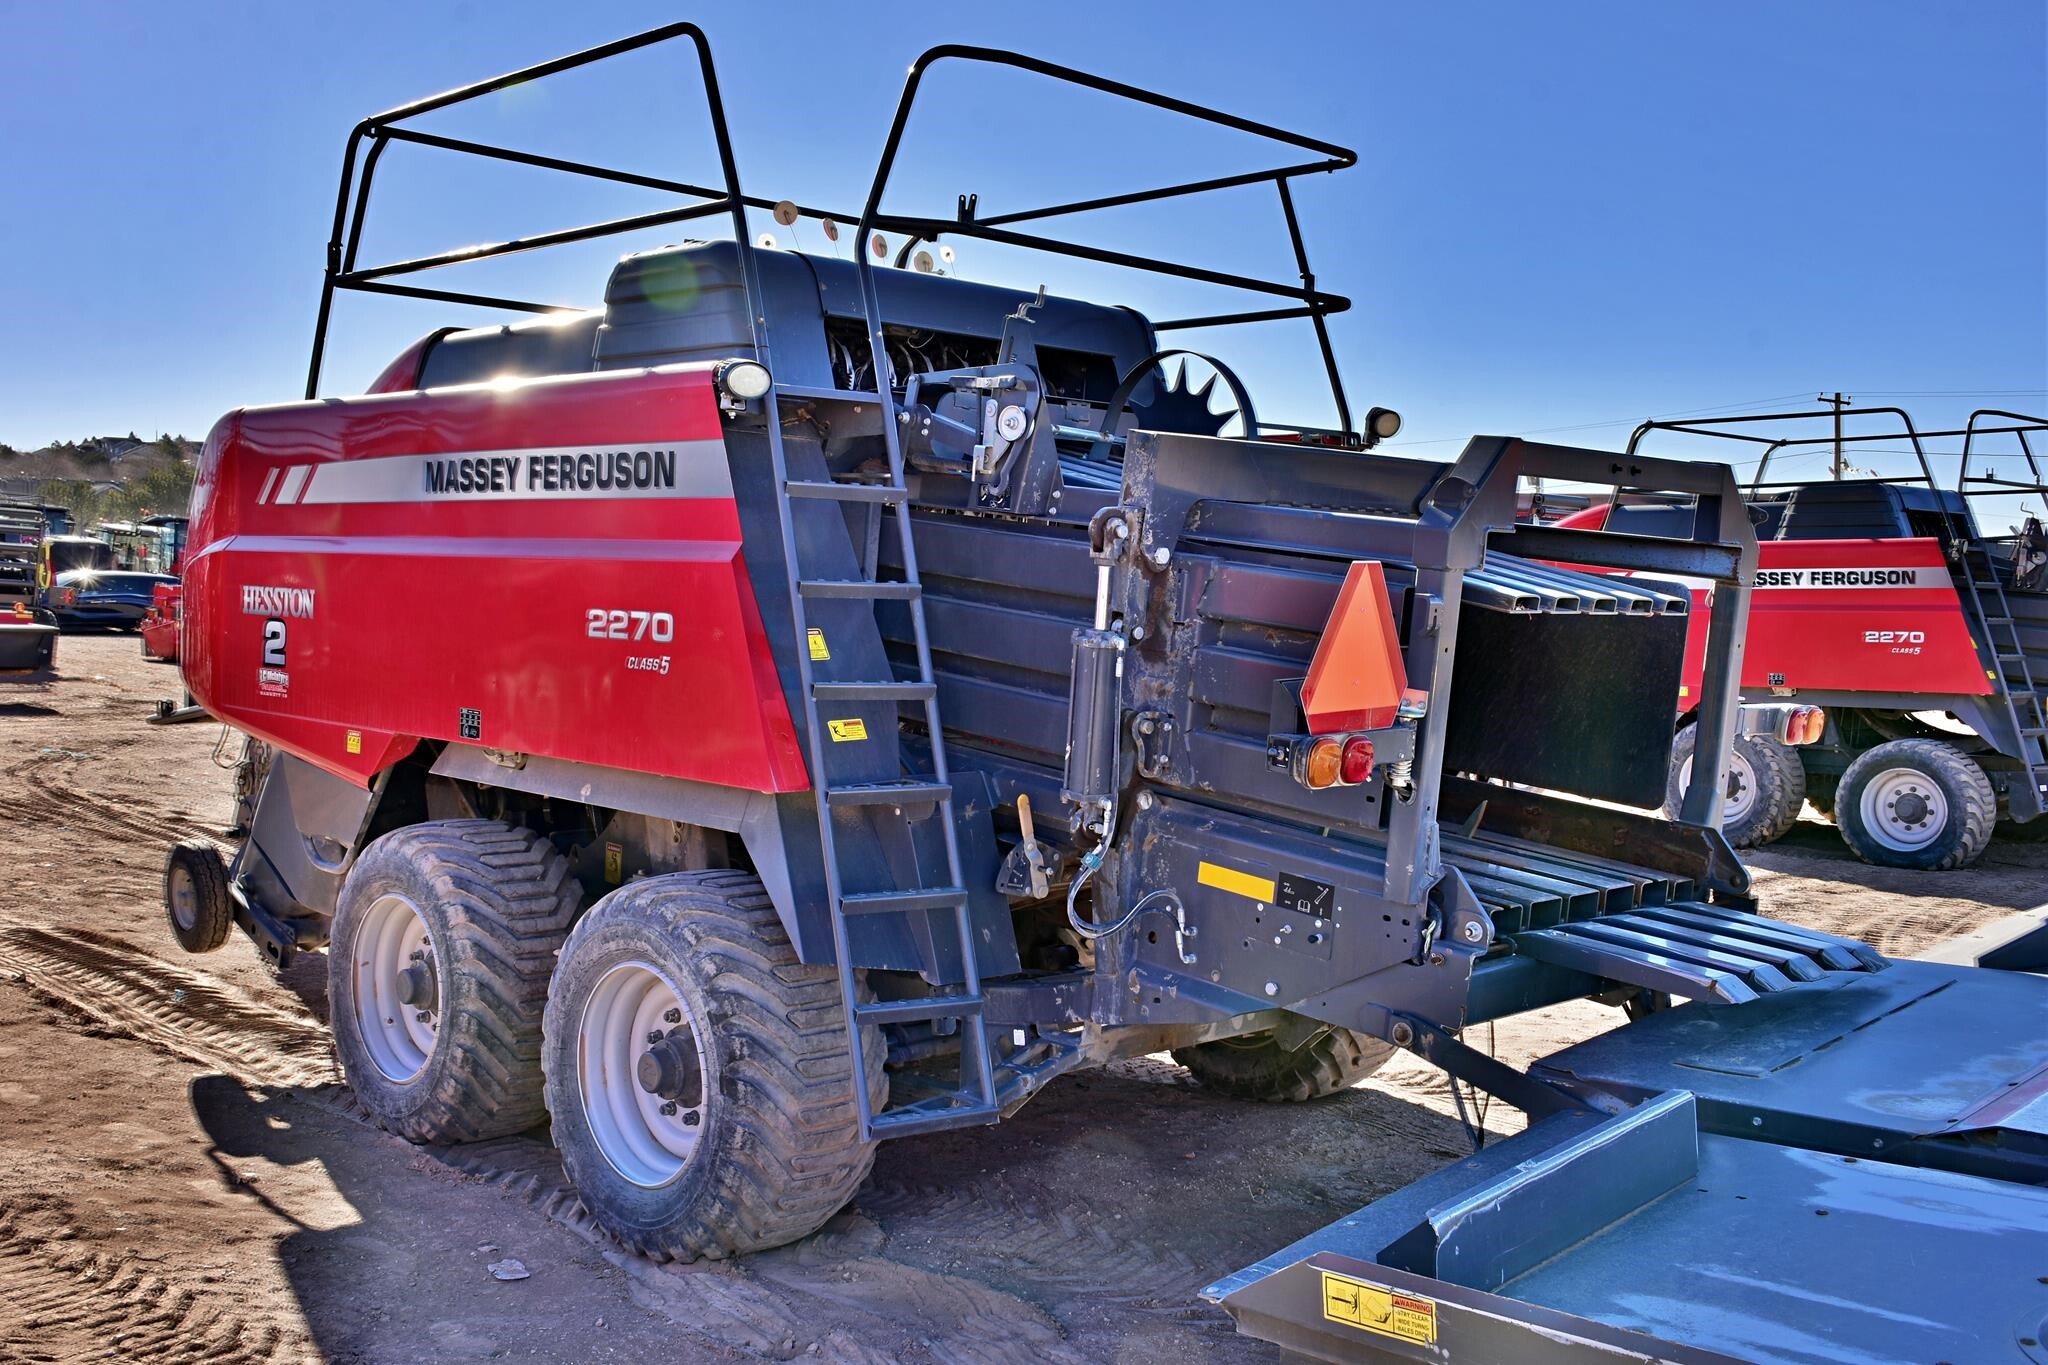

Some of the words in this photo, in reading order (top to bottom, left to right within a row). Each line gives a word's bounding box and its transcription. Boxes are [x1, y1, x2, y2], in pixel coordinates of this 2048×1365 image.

[425, 456, 521, 494] MASSEY
[527, 450, 676, 492] FERGUSON
[1752, 571, 1804, 586] SSEY
[1810, 570, 1916, 586] FERGUSON
[242, 585, 315, 619] HESSTON
[586, 608, 674, 643] 2270
[1864, 631, 1925, 643] 2270
[262, 617, 287, 667] 2
[627, 656, 660, 671] CLASS
[660, 655, 671, 675] 5
[1399, 1299, 1431, 1313] WARNING
